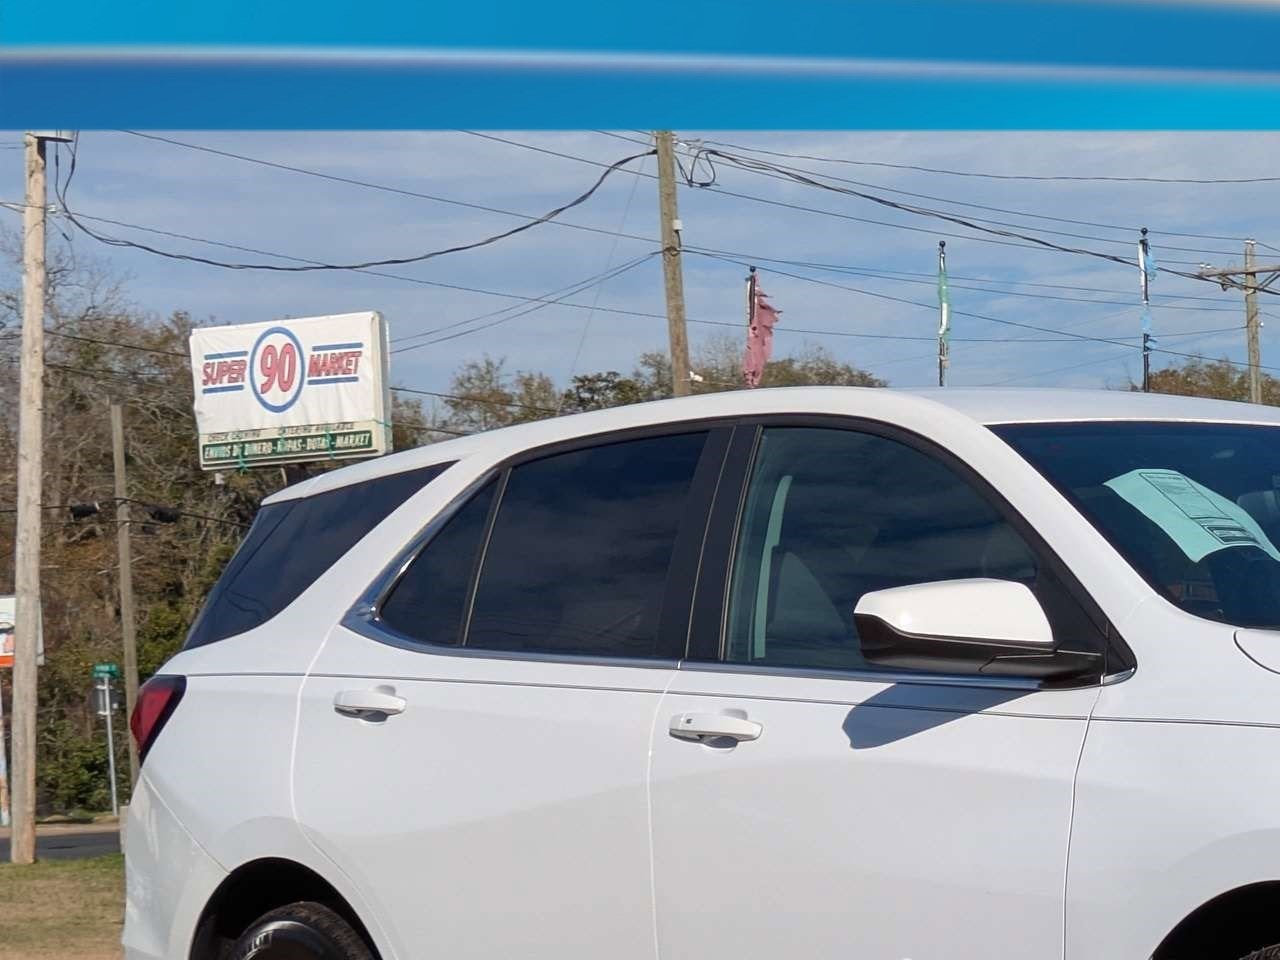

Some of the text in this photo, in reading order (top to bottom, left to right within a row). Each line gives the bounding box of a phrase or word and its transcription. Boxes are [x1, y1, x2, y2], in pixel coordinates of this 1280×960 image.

[202, 342, 362, 395] SUPER 90 MARKET
